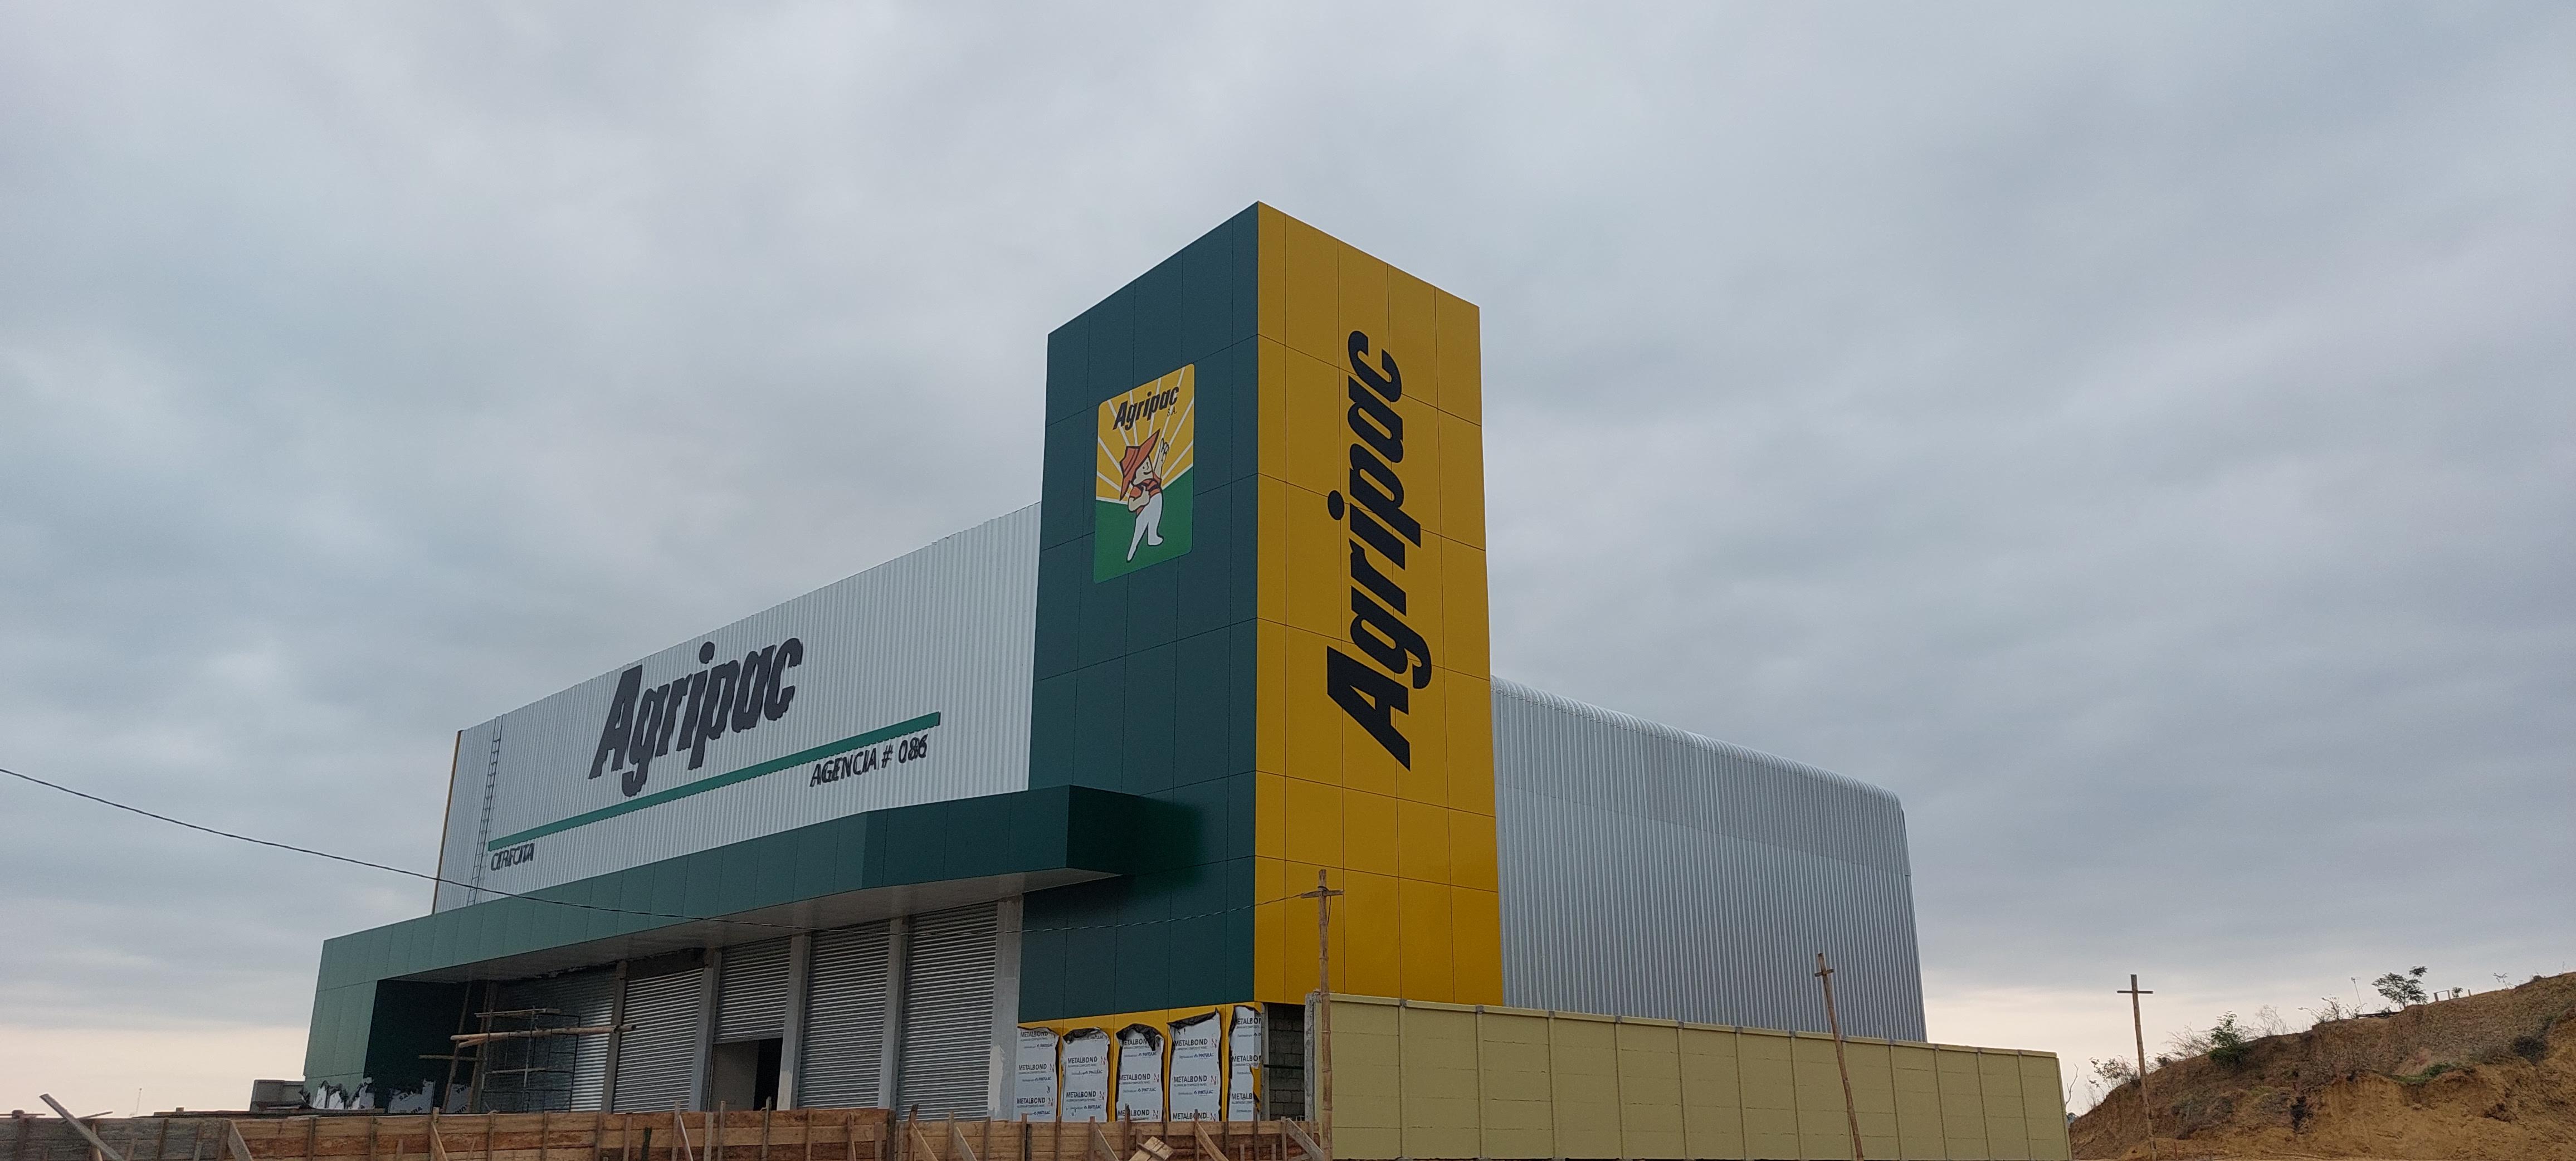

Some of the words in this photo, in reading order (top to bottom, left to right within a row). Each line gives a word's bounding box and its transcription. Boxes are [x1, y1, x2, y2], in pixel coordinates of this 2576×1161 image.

[1113, 387, 1179, 431] Agripac
[1327, 330, 1432, 771] Agripac
[588, 638, 803, 797] Agripac
[809, 748, 877, 787] AGENCIA
[881, 744, 894, 768] #
[899, 734, 928, 763] 086
[1068, 1056, 1097, 1064] METALBOND
[1173, 1075, 1207, 1083] METALBOND
